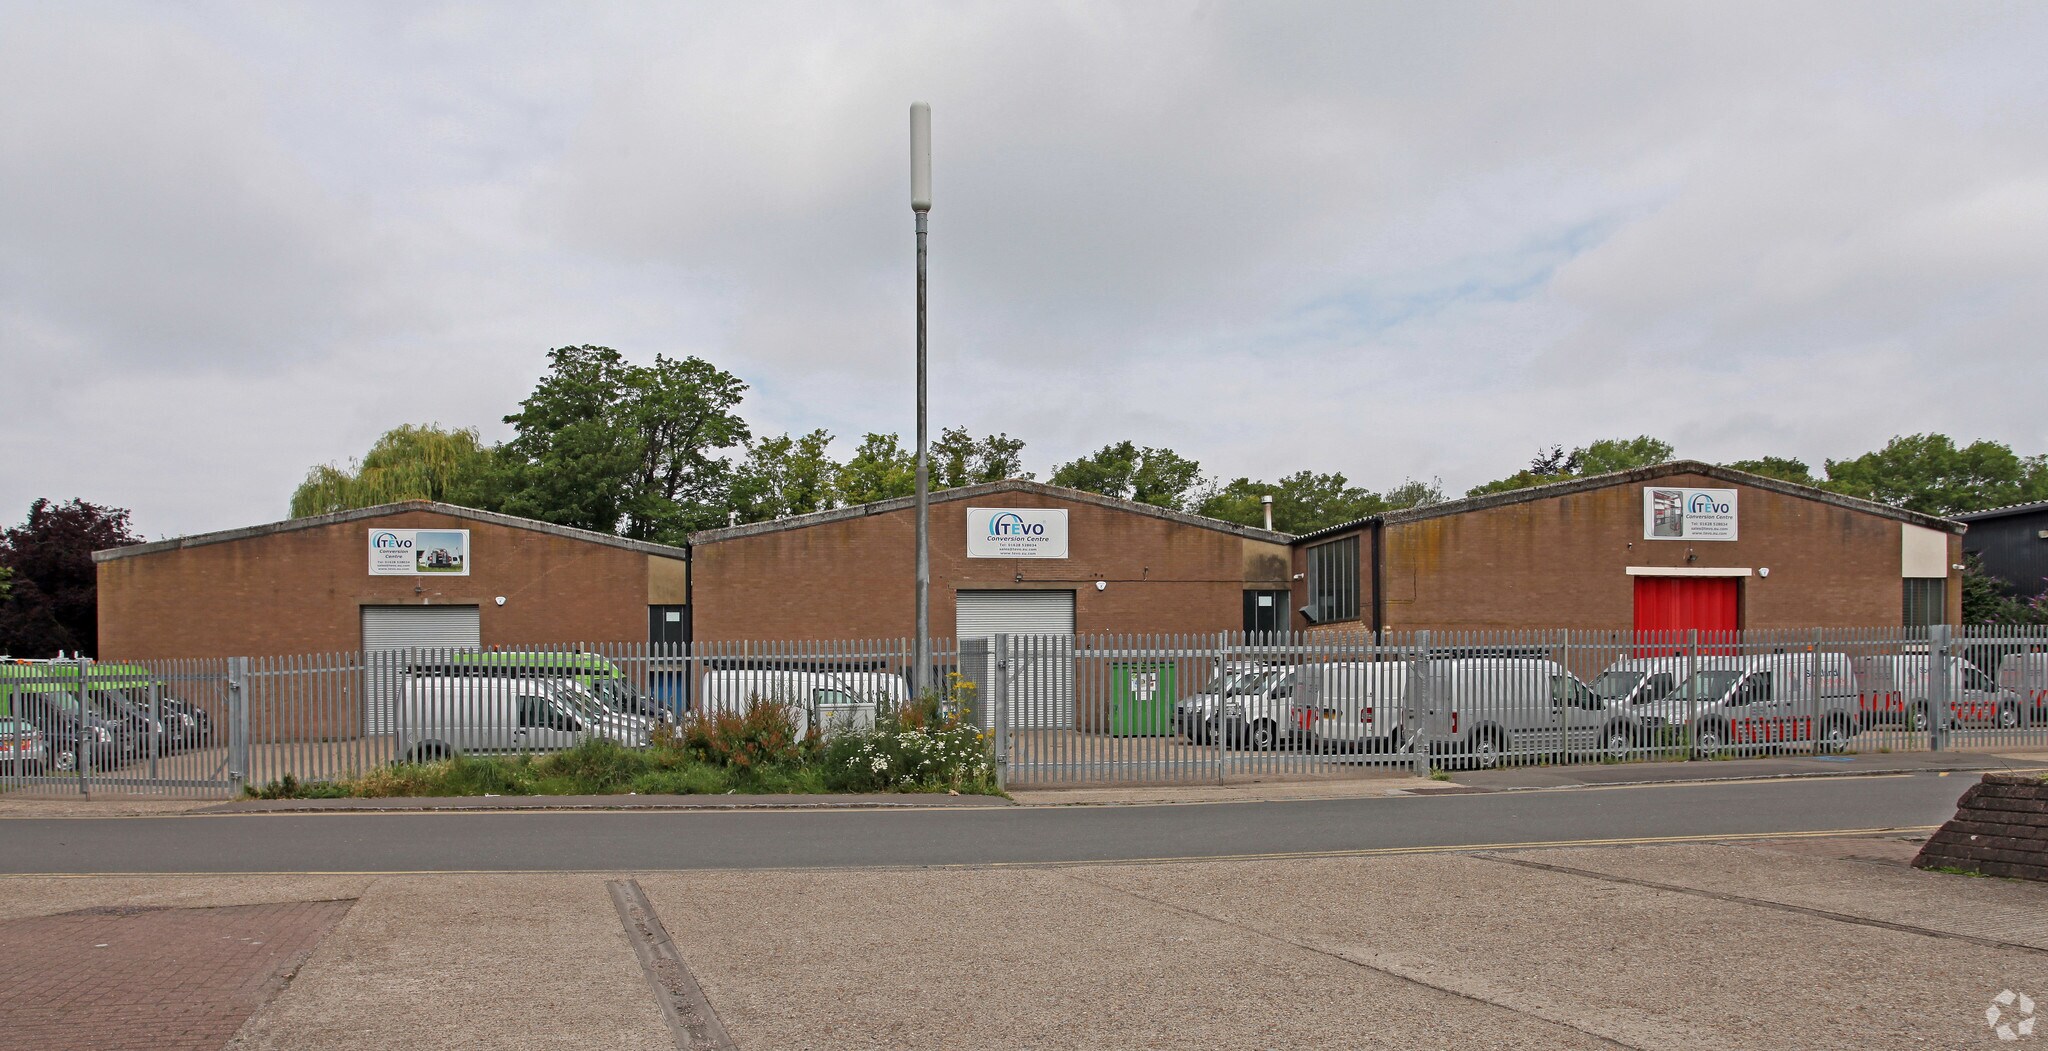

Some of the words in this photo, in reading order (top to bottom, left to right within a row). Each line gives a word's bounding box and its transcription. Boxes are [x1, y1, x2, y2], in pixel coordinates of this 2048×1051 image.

[1697, 503, 1729, 513] TEVO
[1001, 523, 1044, 535] TEVO
[381, 540, 412, 548] TEVO
